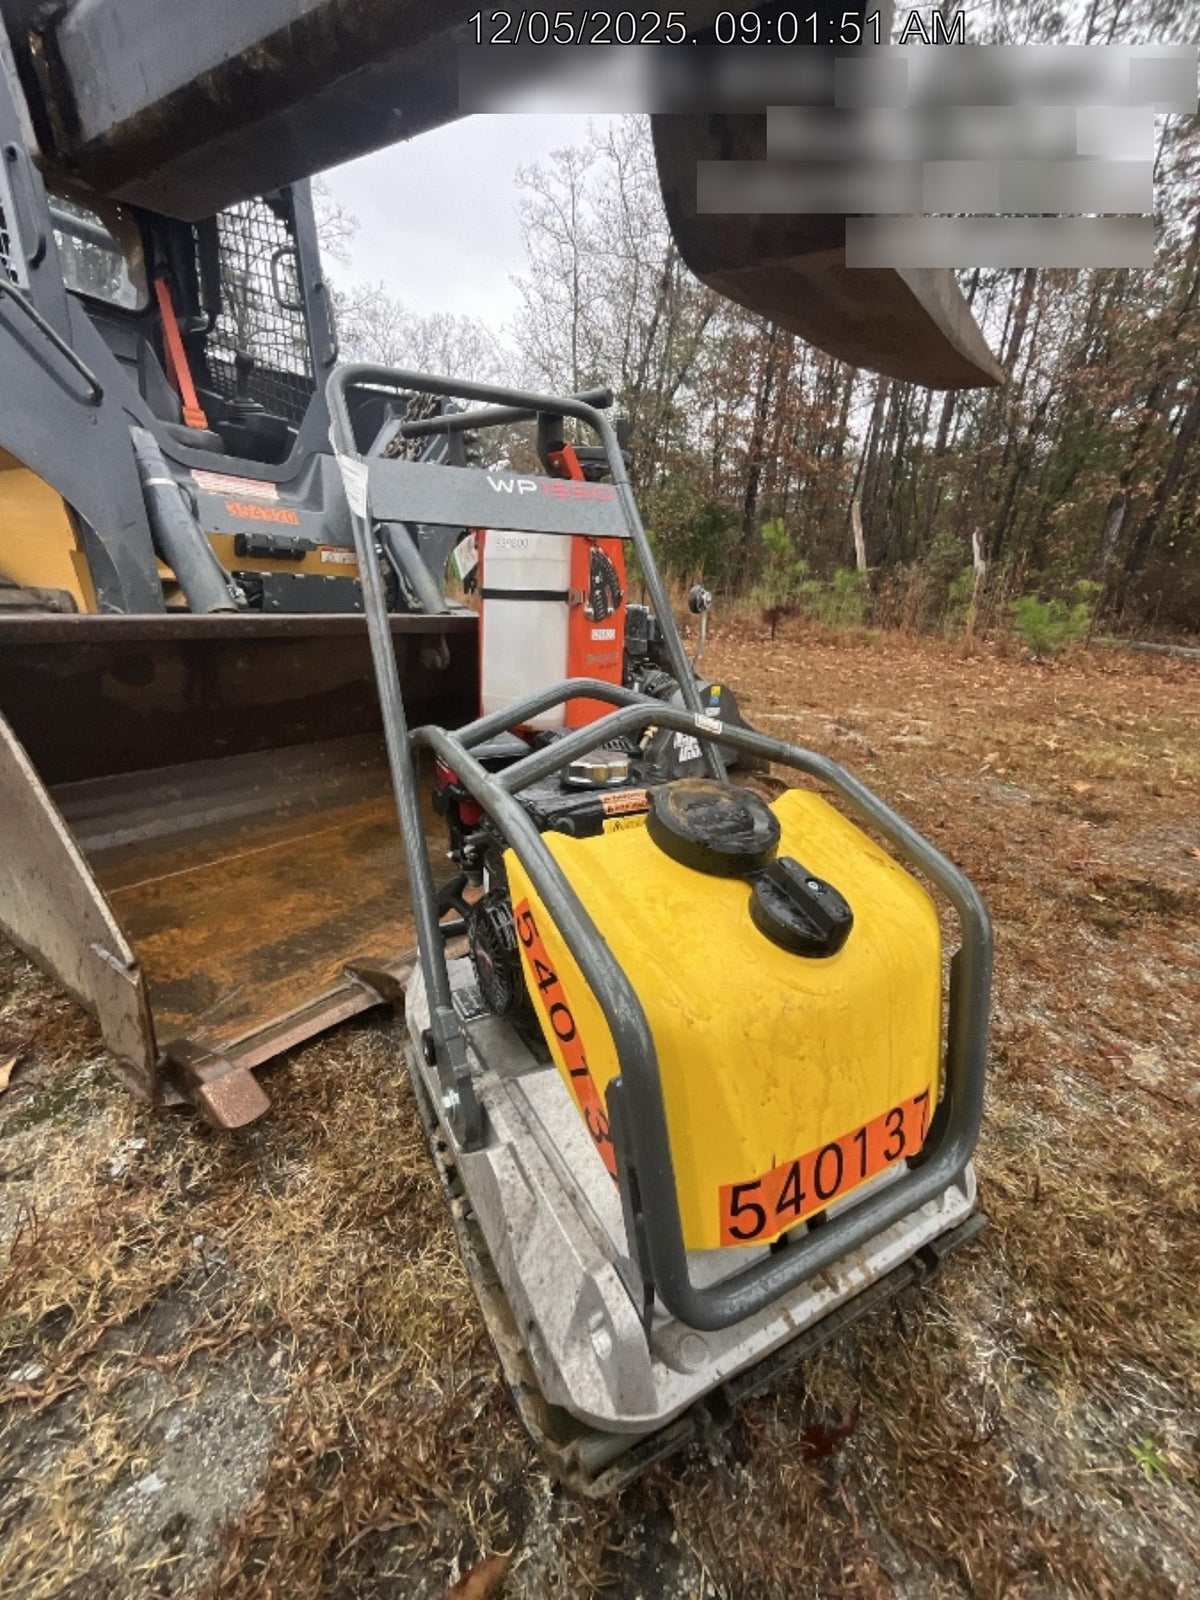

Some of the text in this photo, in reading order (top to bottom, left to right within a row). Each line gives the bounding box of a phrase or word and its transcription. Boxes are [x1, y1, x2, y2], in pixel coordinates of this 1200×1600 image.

[486, 475, 614, 503] WP1550
[515, 910, 619, 1184] 54013
[728, 1087, 930, 1240] 540137
